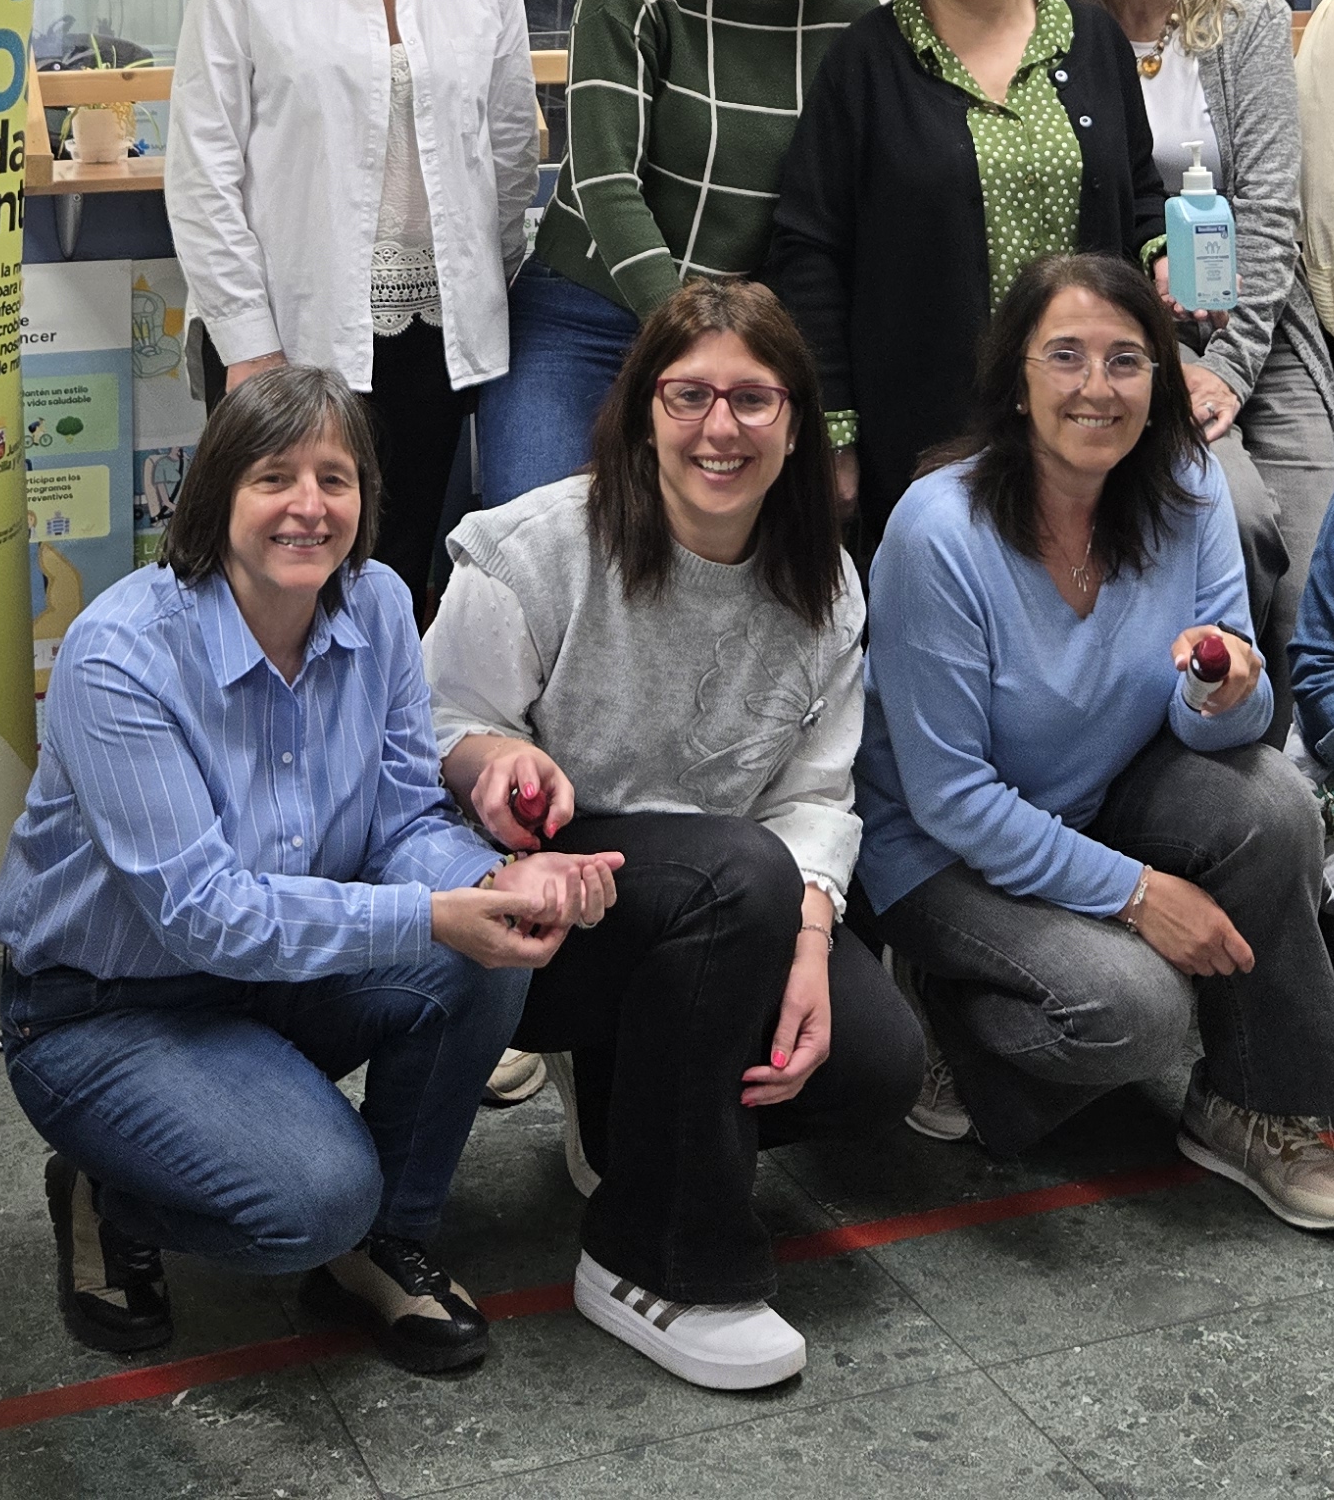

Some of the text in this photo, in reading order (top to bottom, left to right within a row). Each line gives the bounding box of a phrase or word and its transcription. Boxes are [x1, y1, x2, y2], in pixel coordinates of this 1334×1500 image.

[0, 262, 11, 279] la
[20, 332, 57, 344] ncer
[64, 385, 89, 395] estilo
[27, 395, 92, 407] vida saludable
[27, 474, 55, 485] rticipa
[68, 473, 81, 482] los
[27, 492, 74, 502] reventivos
